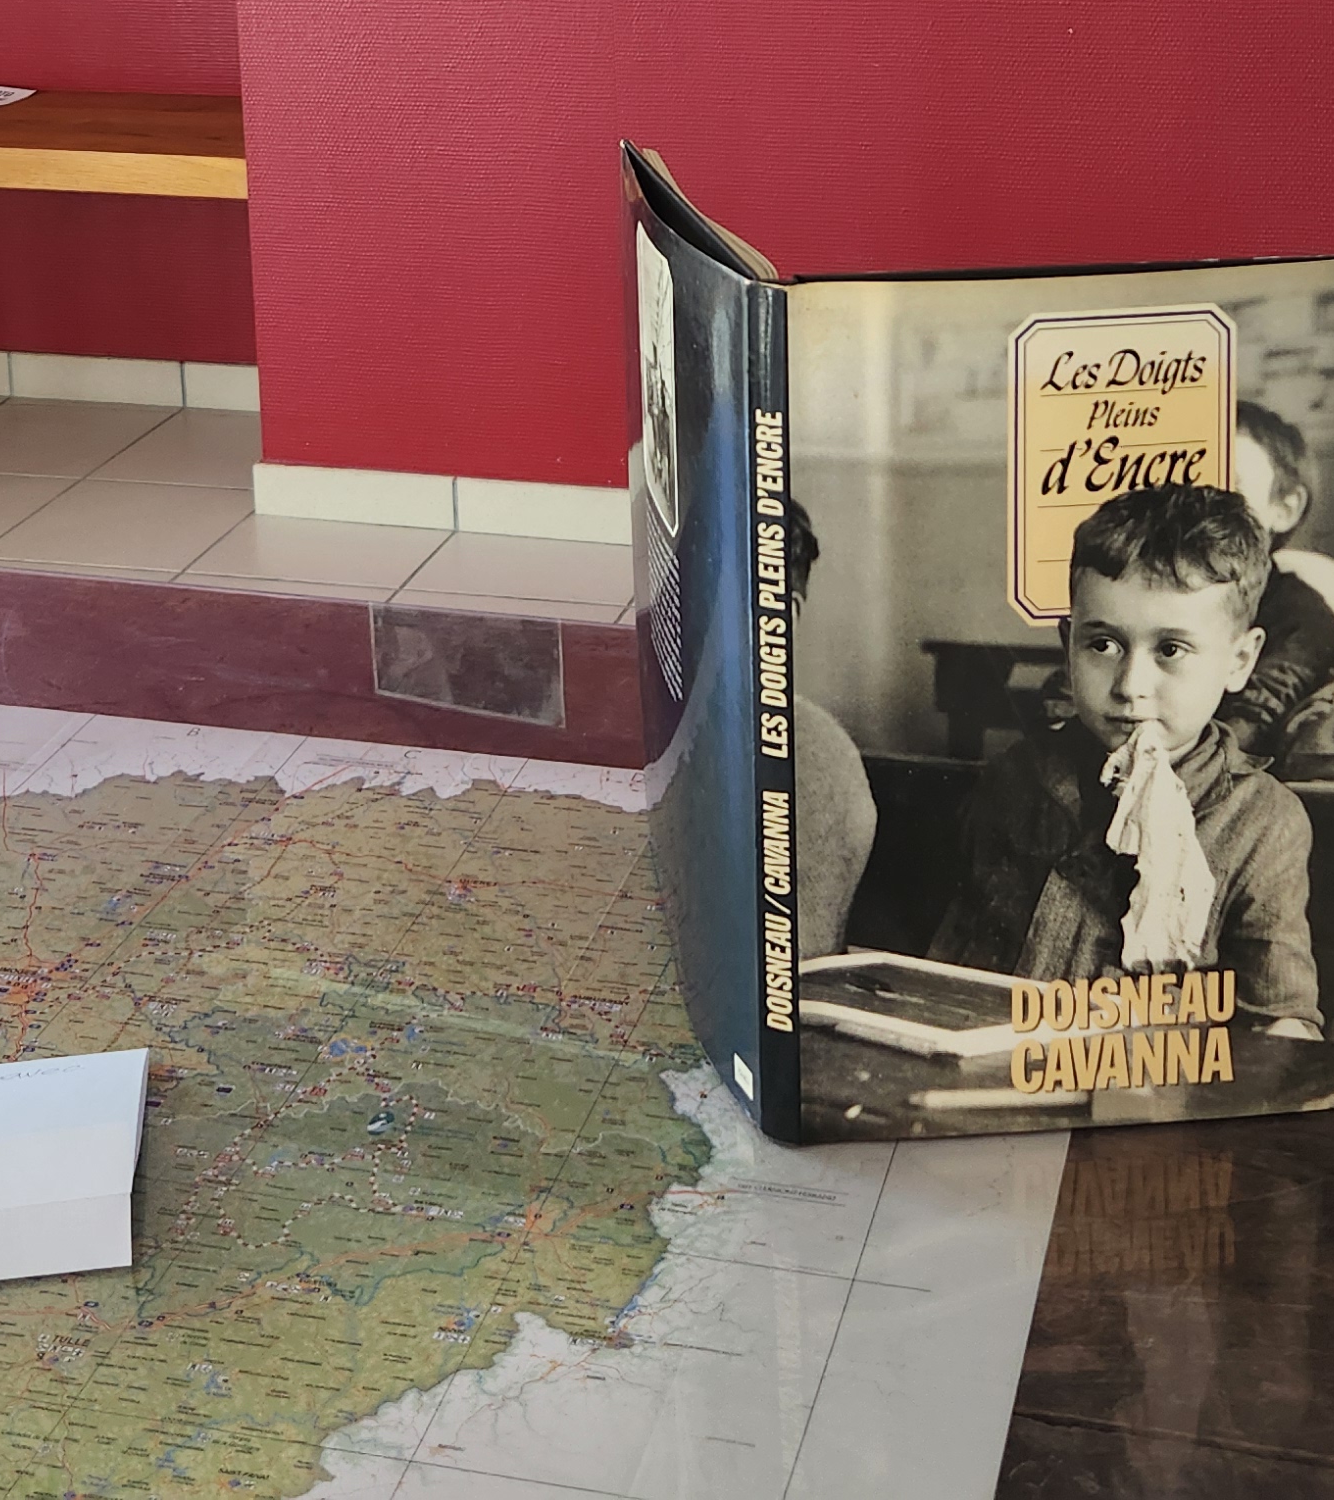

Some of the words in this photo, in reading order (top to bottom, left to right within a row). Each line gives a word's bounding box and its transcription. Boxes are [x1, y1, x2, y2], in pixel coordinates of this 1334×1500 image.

[1040, 350, 1101, 391] Les
[1105, 348, 1207, 395] Doigts
[1086, 399, 1161, 430] Pleins
[755, 408, 785, 517] D'ENCRE
[1041, 435, 1207, 496] d'Encre
[757, 522, 787, 611] PLEINS
[759, 615, 788, 708] DOIGTS
[761, 711, 789, 759] LES
[762, 790, 792, 895] CAVANNA
[764, 911, 794, 1032] DOISNEAU
[1010, 969, 1237, 1032] DOISNEAU
[1010, 1026, 1235, 1093] CAVANNA
[54, 1334, 91, 1347] TULLE
